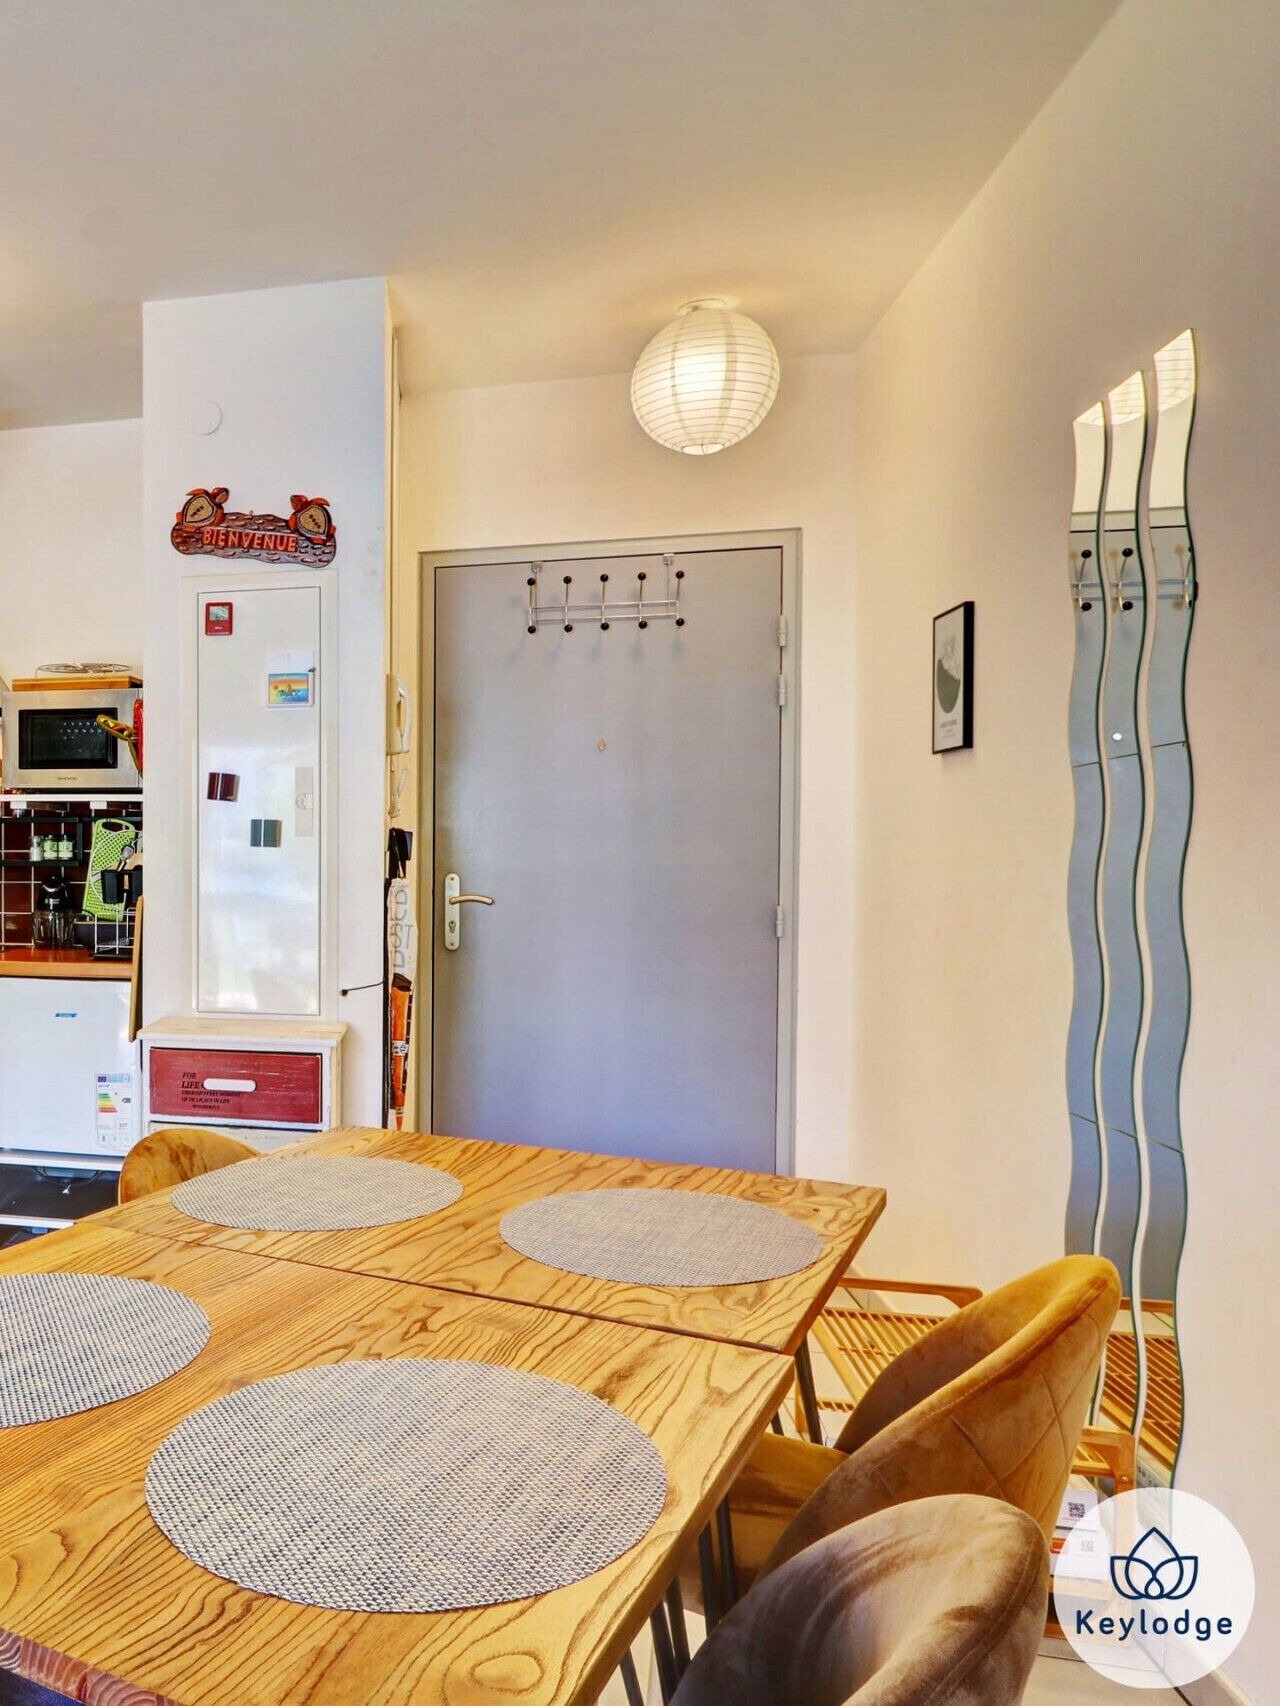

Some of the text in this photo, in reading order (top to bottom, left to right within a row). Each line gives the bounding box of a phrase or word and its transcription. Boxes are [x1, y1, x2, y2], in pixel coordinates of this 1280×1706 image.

[202, 527, 298, 552] BIENVENUE
[182, 1071, 197, 1080] FOR
[181, 1080, 200, 1089] LIFE
